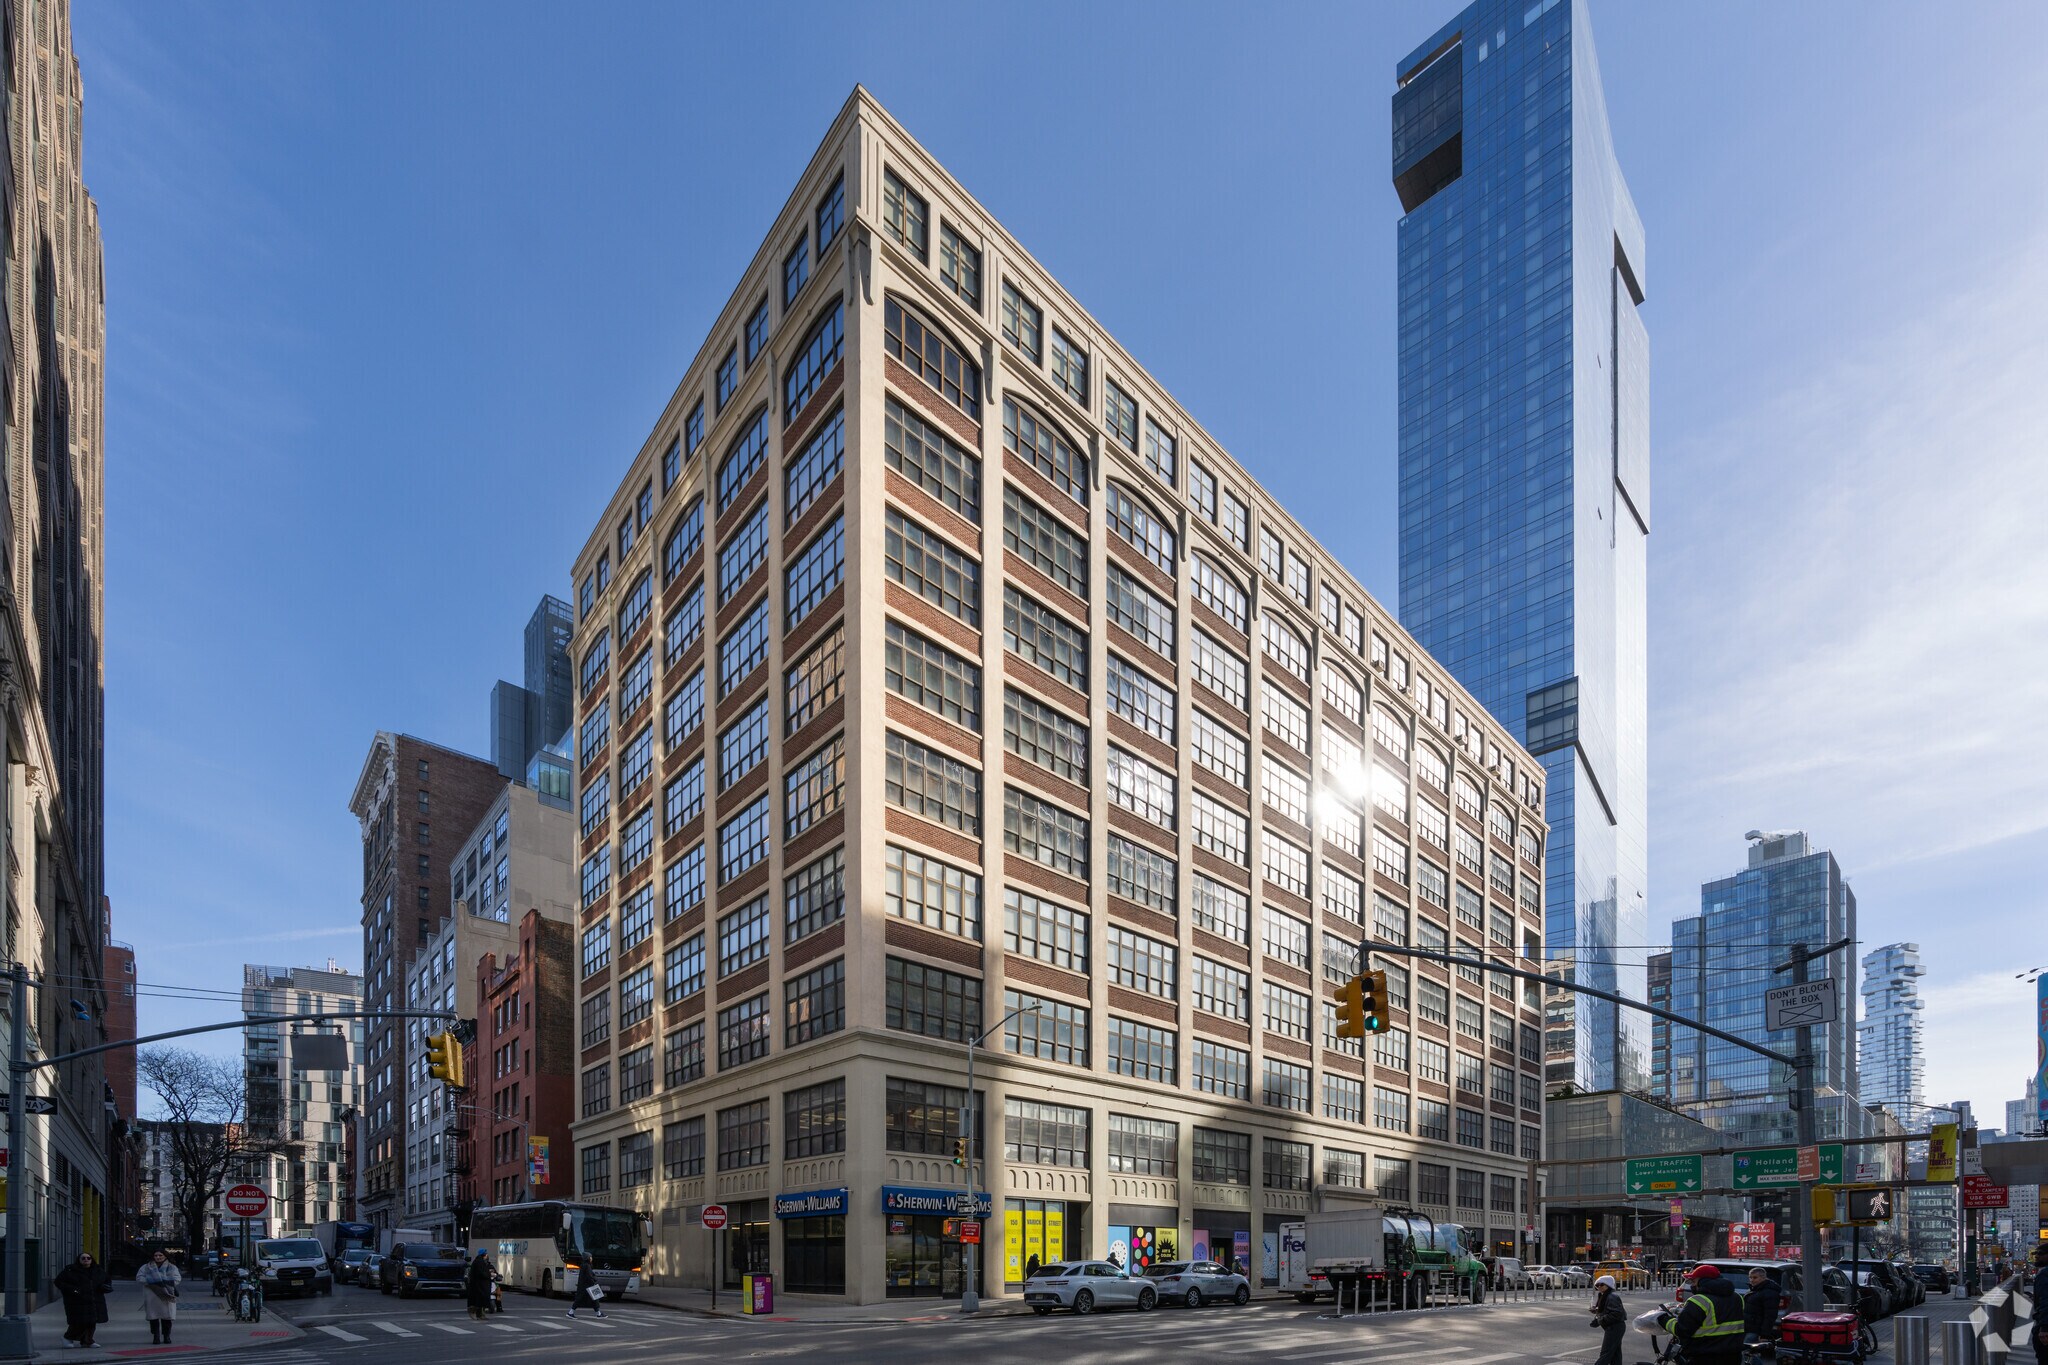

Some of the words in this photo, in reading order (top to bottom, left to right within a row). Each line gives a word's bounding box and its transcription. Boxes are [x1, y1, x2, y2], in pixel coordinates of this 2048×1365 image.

[1770, 989, 1795, 1000] DON'T
[1799, 983, 1829, 994] BLOCK
[1781, 998, 1797, 1007] THE
[1802, 994, 1820, 1003] BOX
[1659, 1158, 1692, 1167] TRAFFIC
[1738, 1158, 1749, 1166] 78
[1755, 1157, 1794, 1166] Holland
[778, 1196, 841, 1214] SHERWIN-WILLIAMS
[1236, 1232, 1247, 1240] RIGHT
[1732, 1235, 1770, 1244] PARK
[1736, 1245, 1766, 1253] HERE
